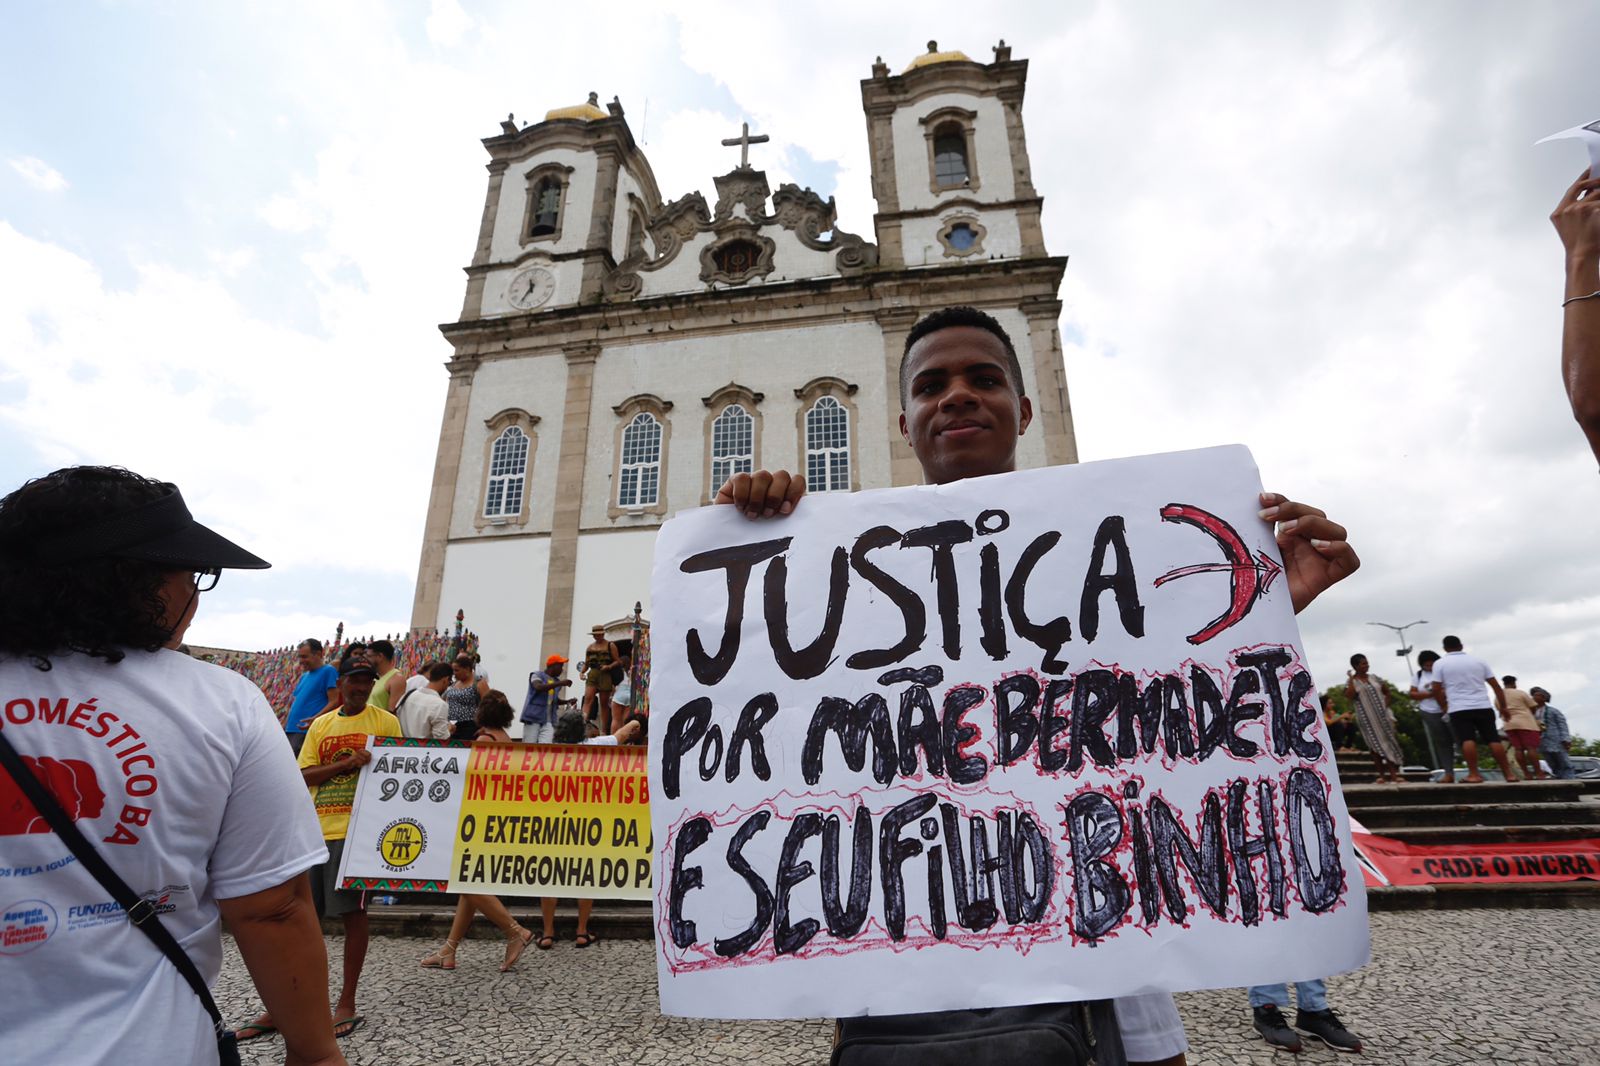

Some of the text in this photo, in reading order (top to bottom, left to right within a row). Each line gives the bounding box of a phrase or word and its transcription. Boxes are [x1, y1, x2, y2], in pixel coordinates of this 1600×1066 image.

[662, 691, 779, 800] POR
[801, 664, 989, 788] MÃE
[0, 697, 158, 798] OMÉSTICO
[103, 804, 152, 846] BA
[474, 746, 513, 772] THE
[379, 778, 451, 803] 900
[467, 774, 488, 801] IN
[490, 774, 525, 802] THE
[528, 774, 616, 804] COUNTRY
[618, 775, 634, 804] IS
[461, 814, 476, 843] O
[484, 809, 603, 848] EXTERMÍNIO
[612, 818, 639, 848] DA
[14, 865, 43, 877] PELA
[459, 848, 472, 882] É
[471, 854, 485, 883] A
[490, 855, 595, 887] VERGONHA
[599, 858, 629, 889] DO
[1424, 856, 1489, 878] CADE
[1492, 857, 1511, 877] O
[1512, 854, 1595, 877] INCRA
